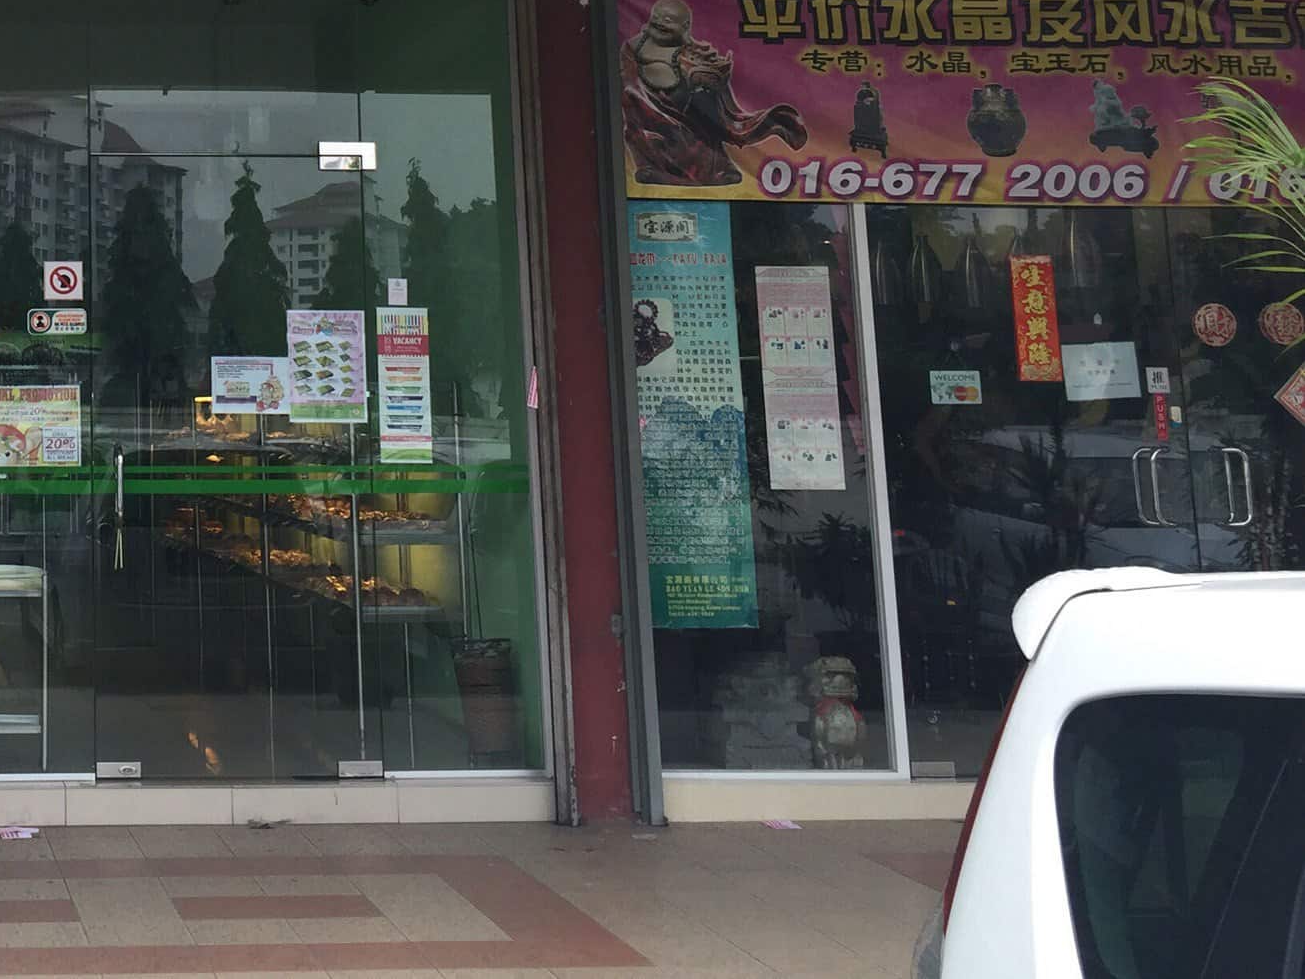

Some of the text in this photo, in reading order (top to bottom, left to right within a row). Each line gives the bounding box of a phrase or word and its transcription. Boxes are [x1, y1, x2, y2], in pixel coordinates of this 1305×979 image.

[760, 161, 983, 199] 016-677
[1007, 164, 1145, 200] 2006
[1168, 164, 1189, 199] /
[392, 337, 422, 346] VACANCY
[19, 388, 77, 402] PROMOTION
[1156, 396, 1166, 430] PUSH
[45, 437, 76, 450] 20%
